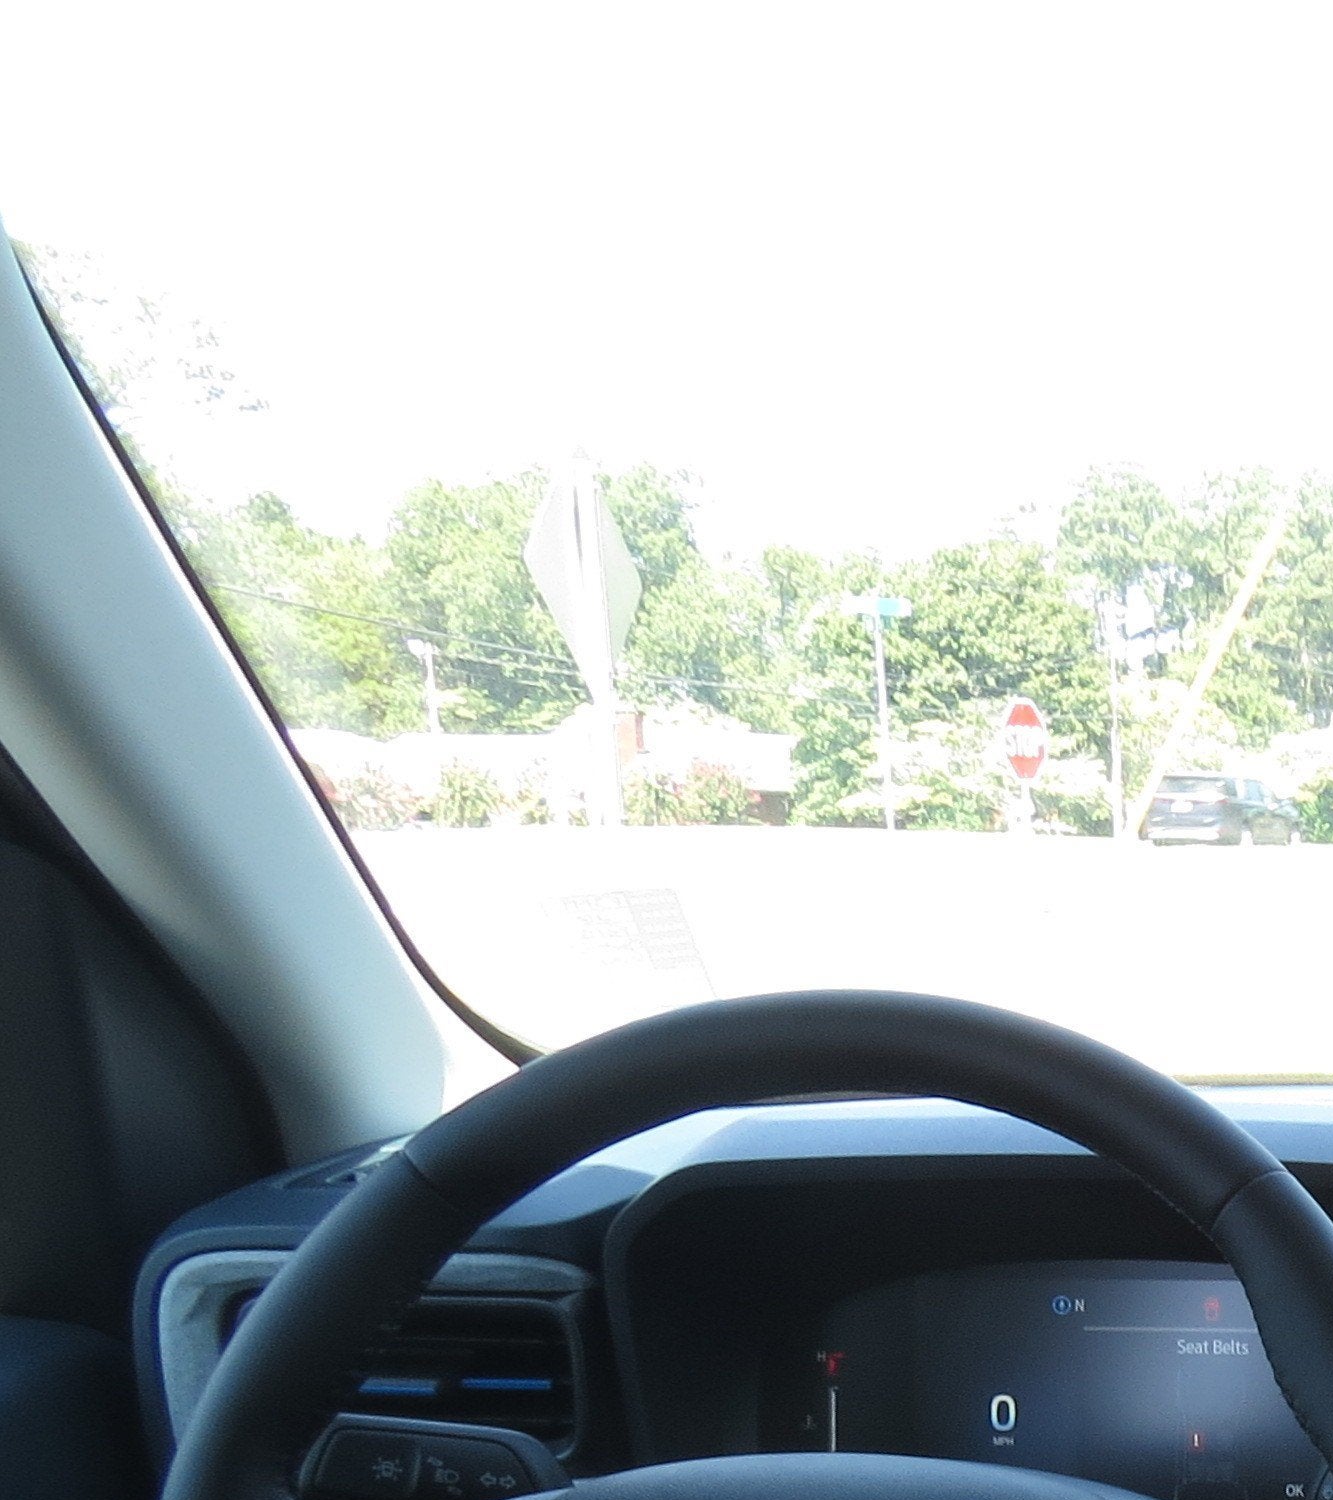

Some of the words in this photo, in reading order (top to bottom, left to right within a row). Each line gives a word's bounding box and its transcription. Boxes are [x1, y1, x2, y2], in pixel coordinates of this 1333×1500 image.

[1176, 1339, 1210, 1355] Seat
[1212, 1339, 1250, 1355] Belts
[989, 1393, 1017, 1432] 0
